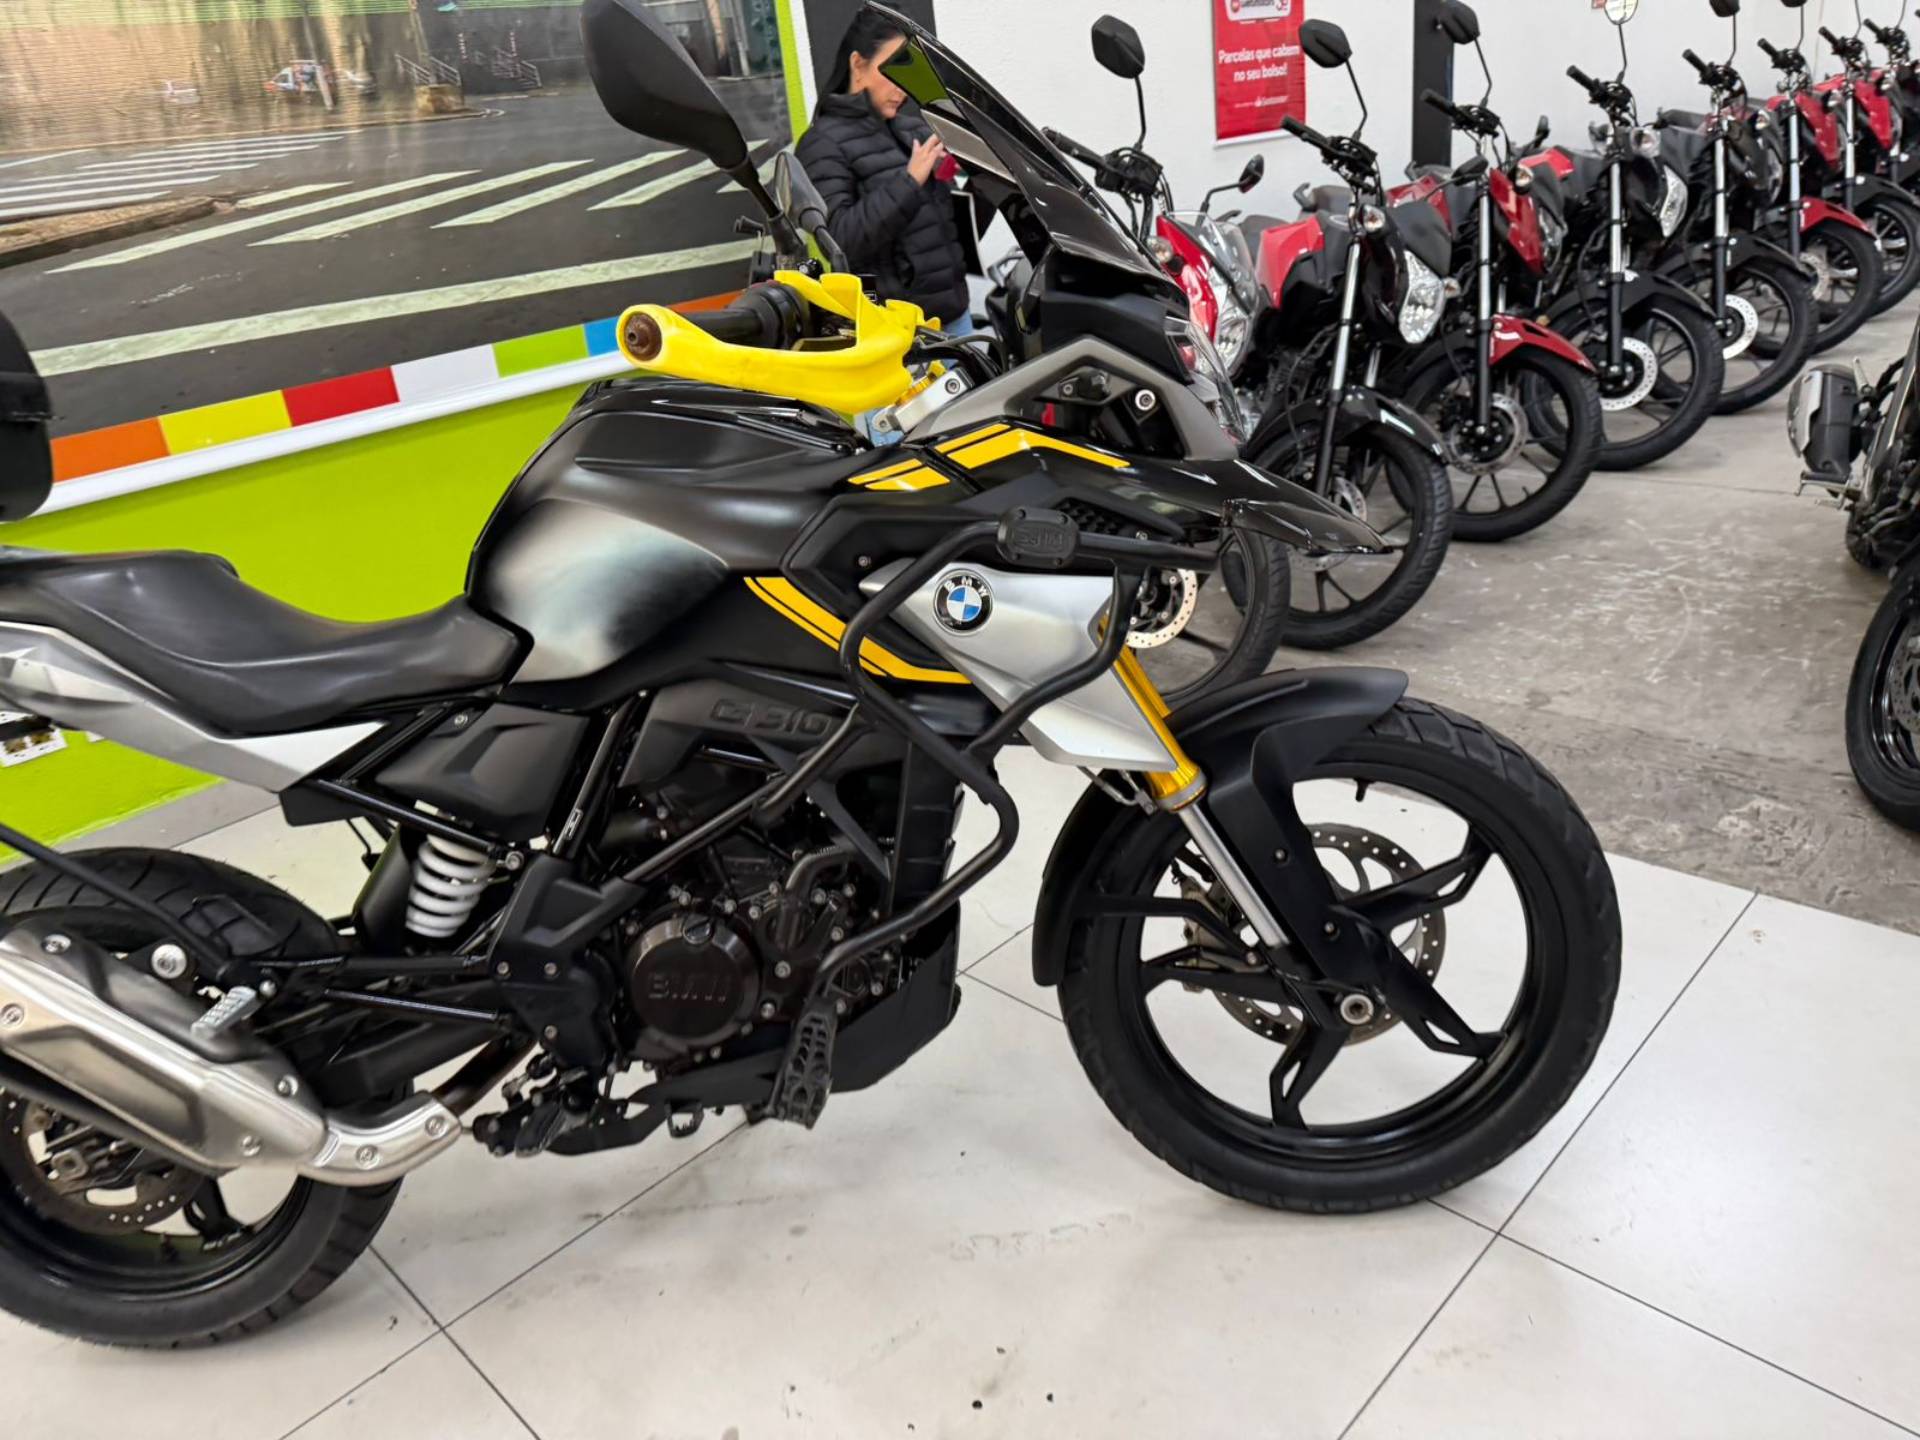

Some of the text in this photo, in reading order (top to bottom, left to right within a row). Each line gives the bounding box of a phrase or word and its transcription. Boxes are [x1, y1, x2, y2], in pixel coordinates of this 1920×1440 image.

[1218, 43, 1300, 64] Parcelas que cabem
[1233, 62, 1288, 82] no seu bolso!
[943, 575, 988, 597] BMW
